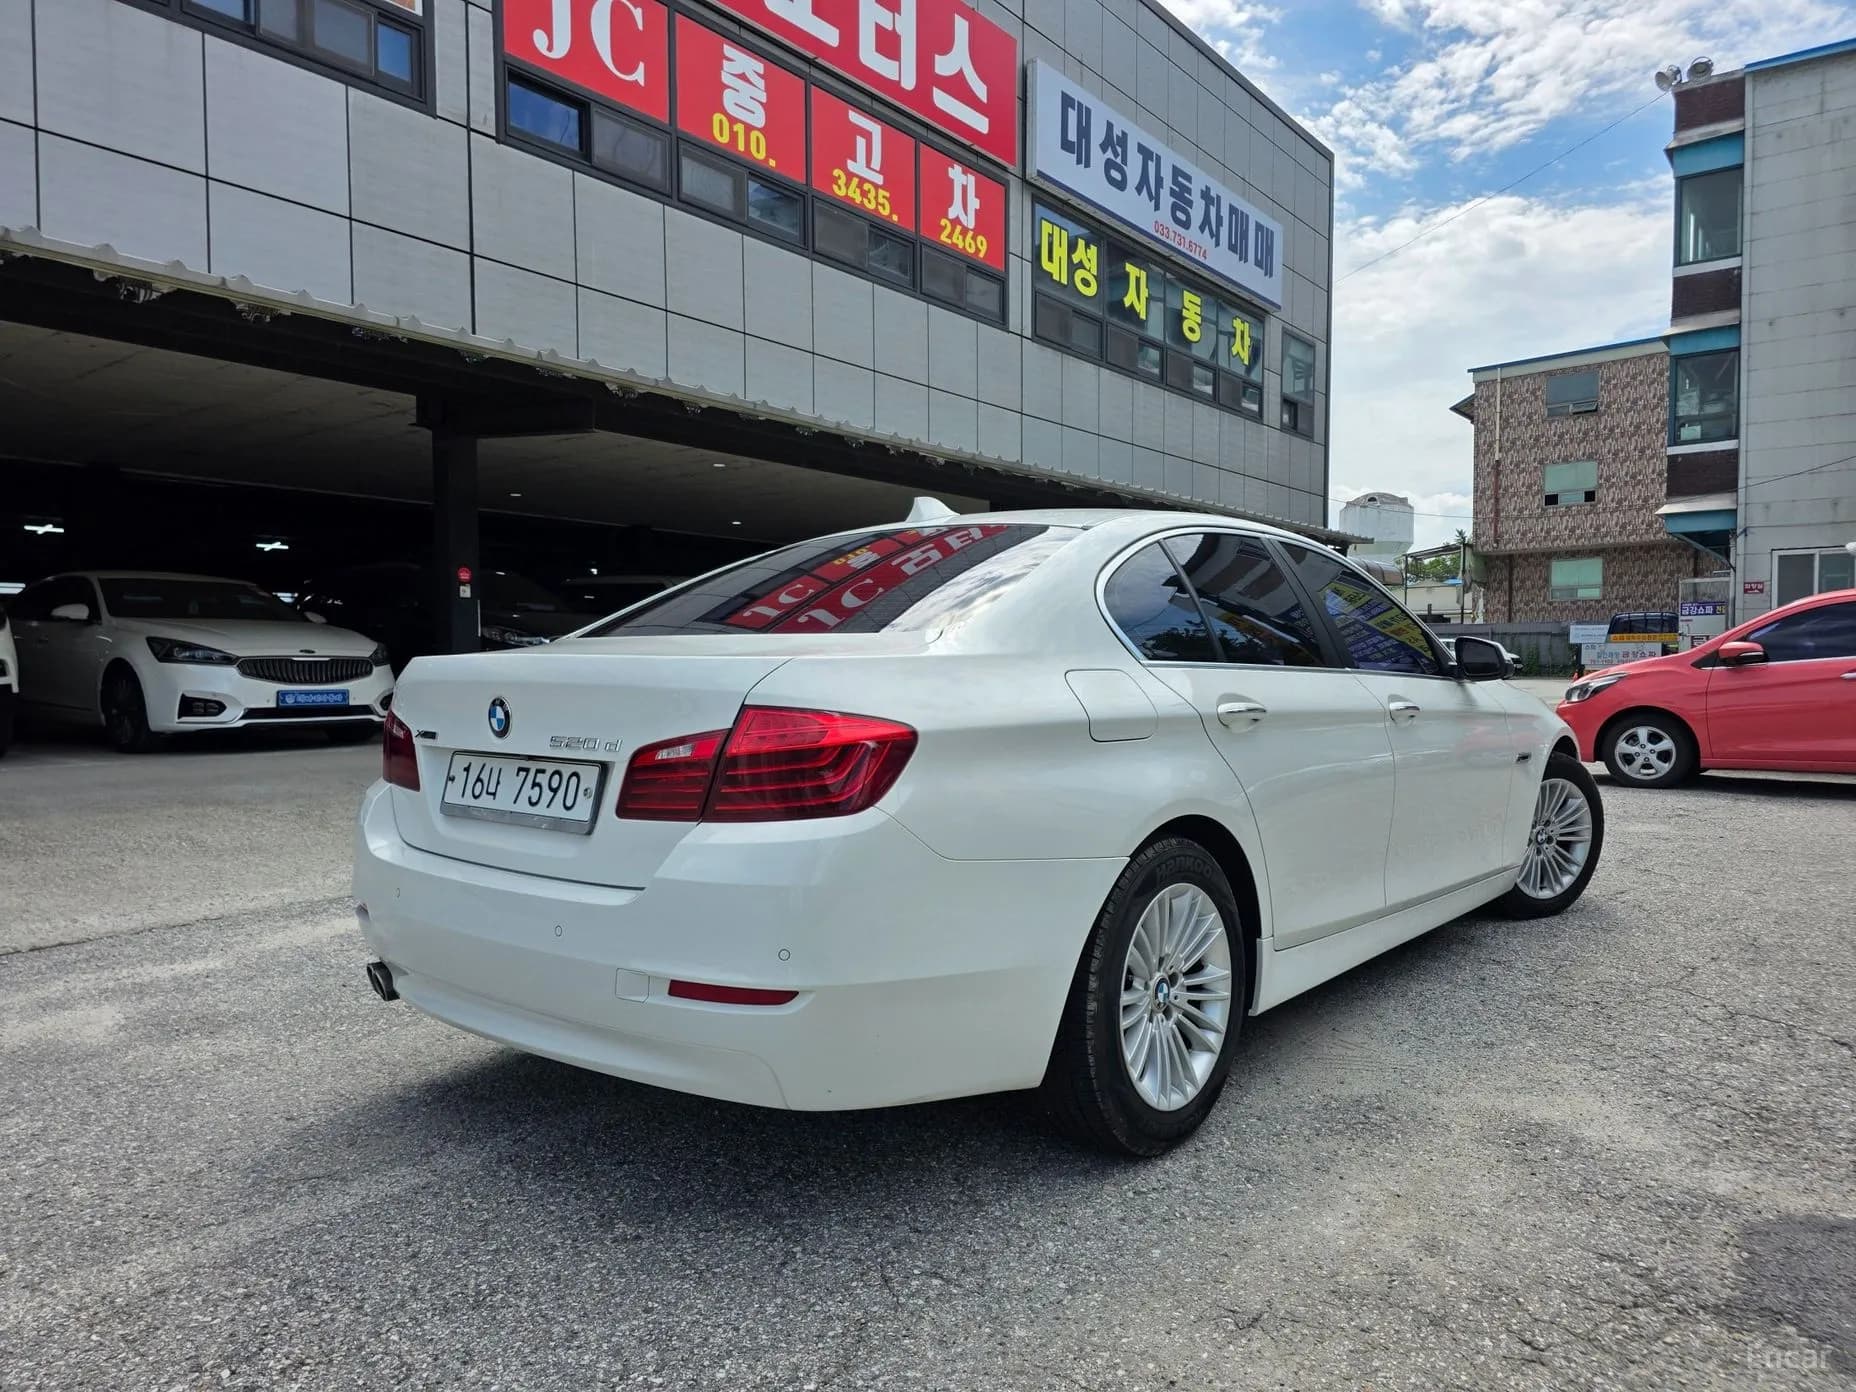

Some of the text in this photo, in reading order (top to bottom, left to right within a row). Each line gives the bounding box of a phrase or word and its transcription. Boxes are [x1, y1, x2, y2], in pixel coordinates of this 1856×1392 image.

[532, 0, 645, 87] JC
[939, 218, 989, 260] 2469
[512, 766, 581, 812] 7590
